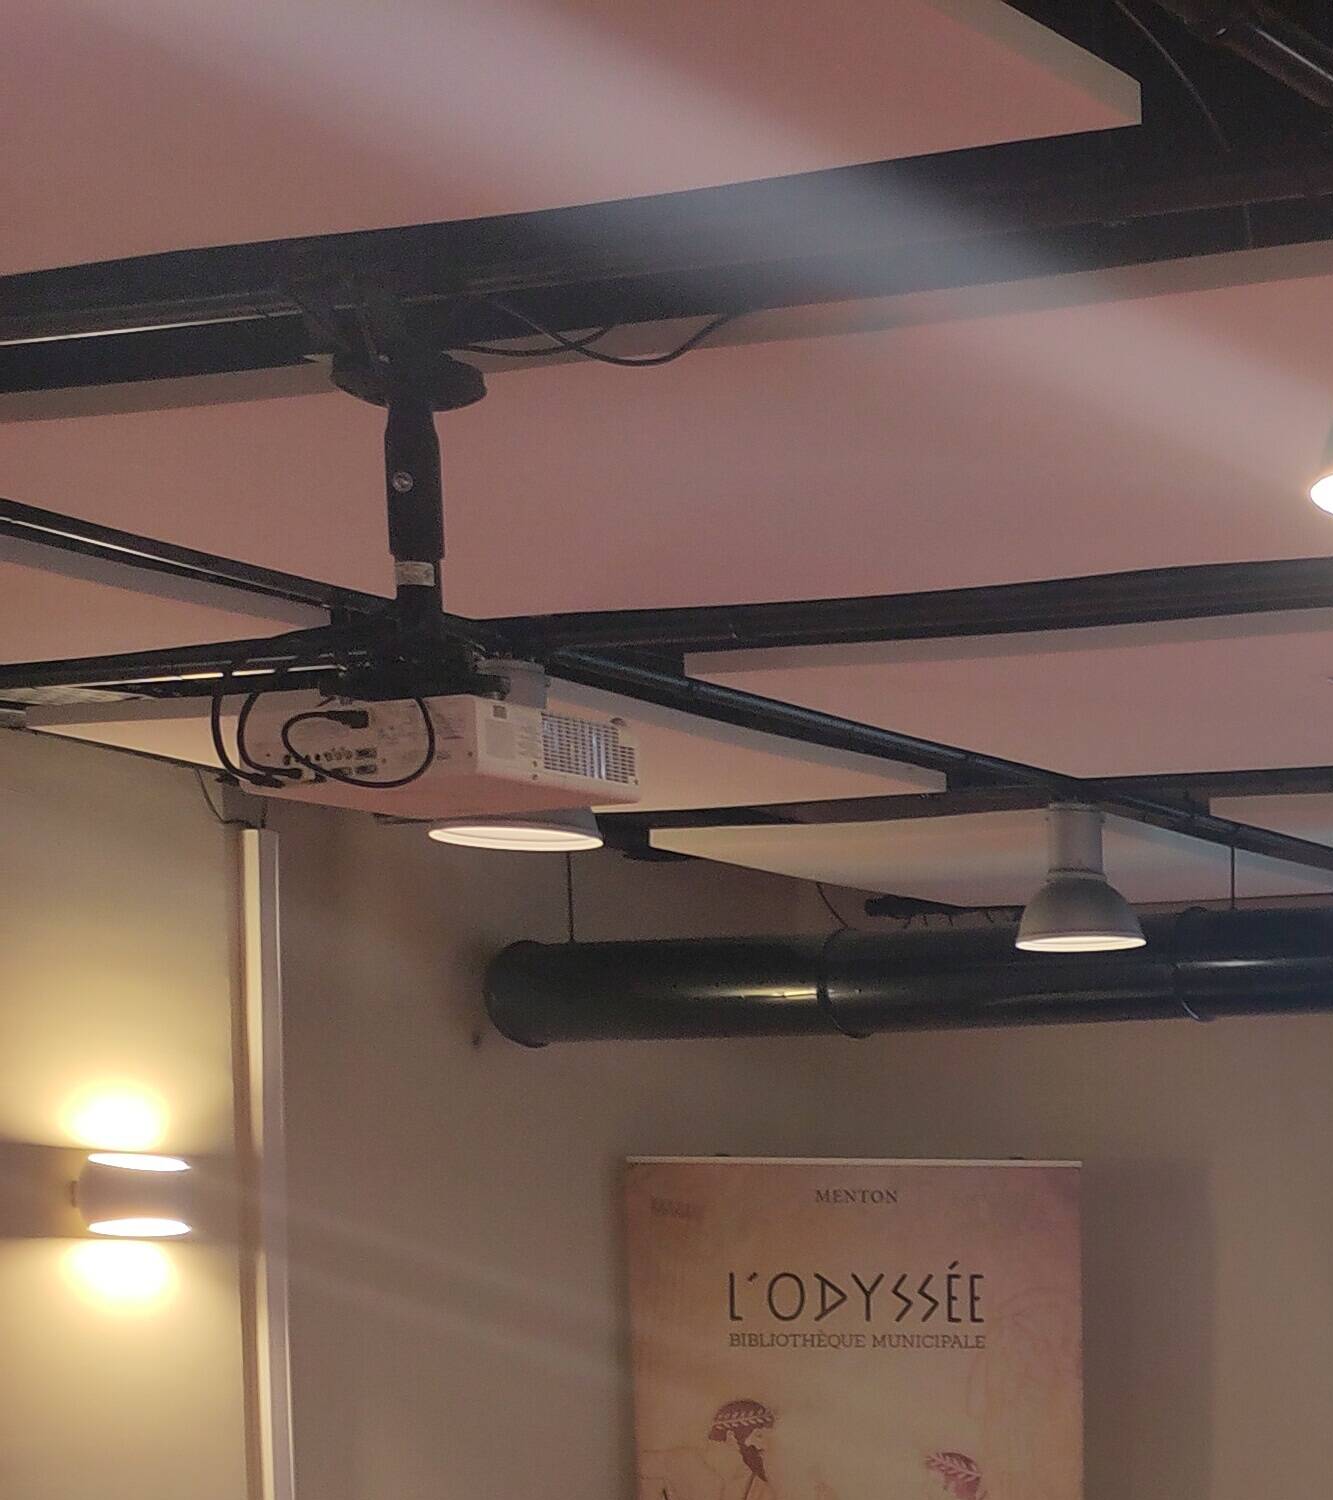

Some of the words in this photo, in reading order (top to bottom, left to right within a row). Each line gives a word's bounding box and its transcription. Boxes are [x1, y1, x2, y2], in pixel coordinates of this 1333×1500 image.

[815, 1189, 898, 1204] MENTON
[728, 1260, 985, 1324] L'ODYSSÉE
[729, 1329, 866, 1349] BIBLIOTHÈQUE
[872, 1333, 986, 1349] MUNICIPALE
